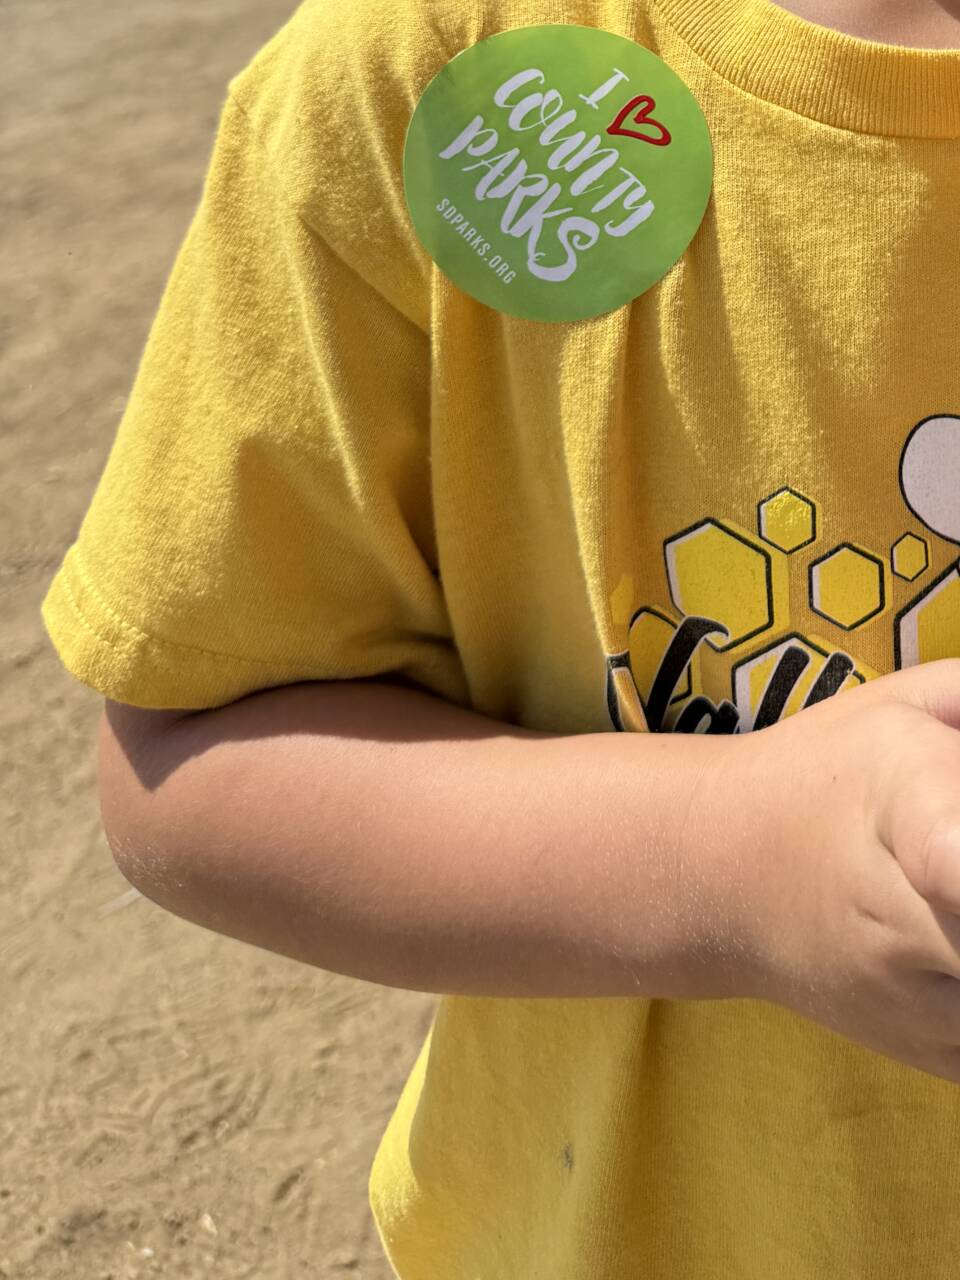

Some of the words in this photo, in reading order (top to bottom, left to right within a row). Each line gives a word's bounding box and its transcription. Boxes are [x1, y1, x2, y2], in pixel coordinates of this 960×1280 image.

[578, 67, 630, 109] I
[438, 115, 600, 282] PARKS
[494, 68, 655, 237] COUNTY
[436, 198, 516, 285] SDPARKS.ORG
